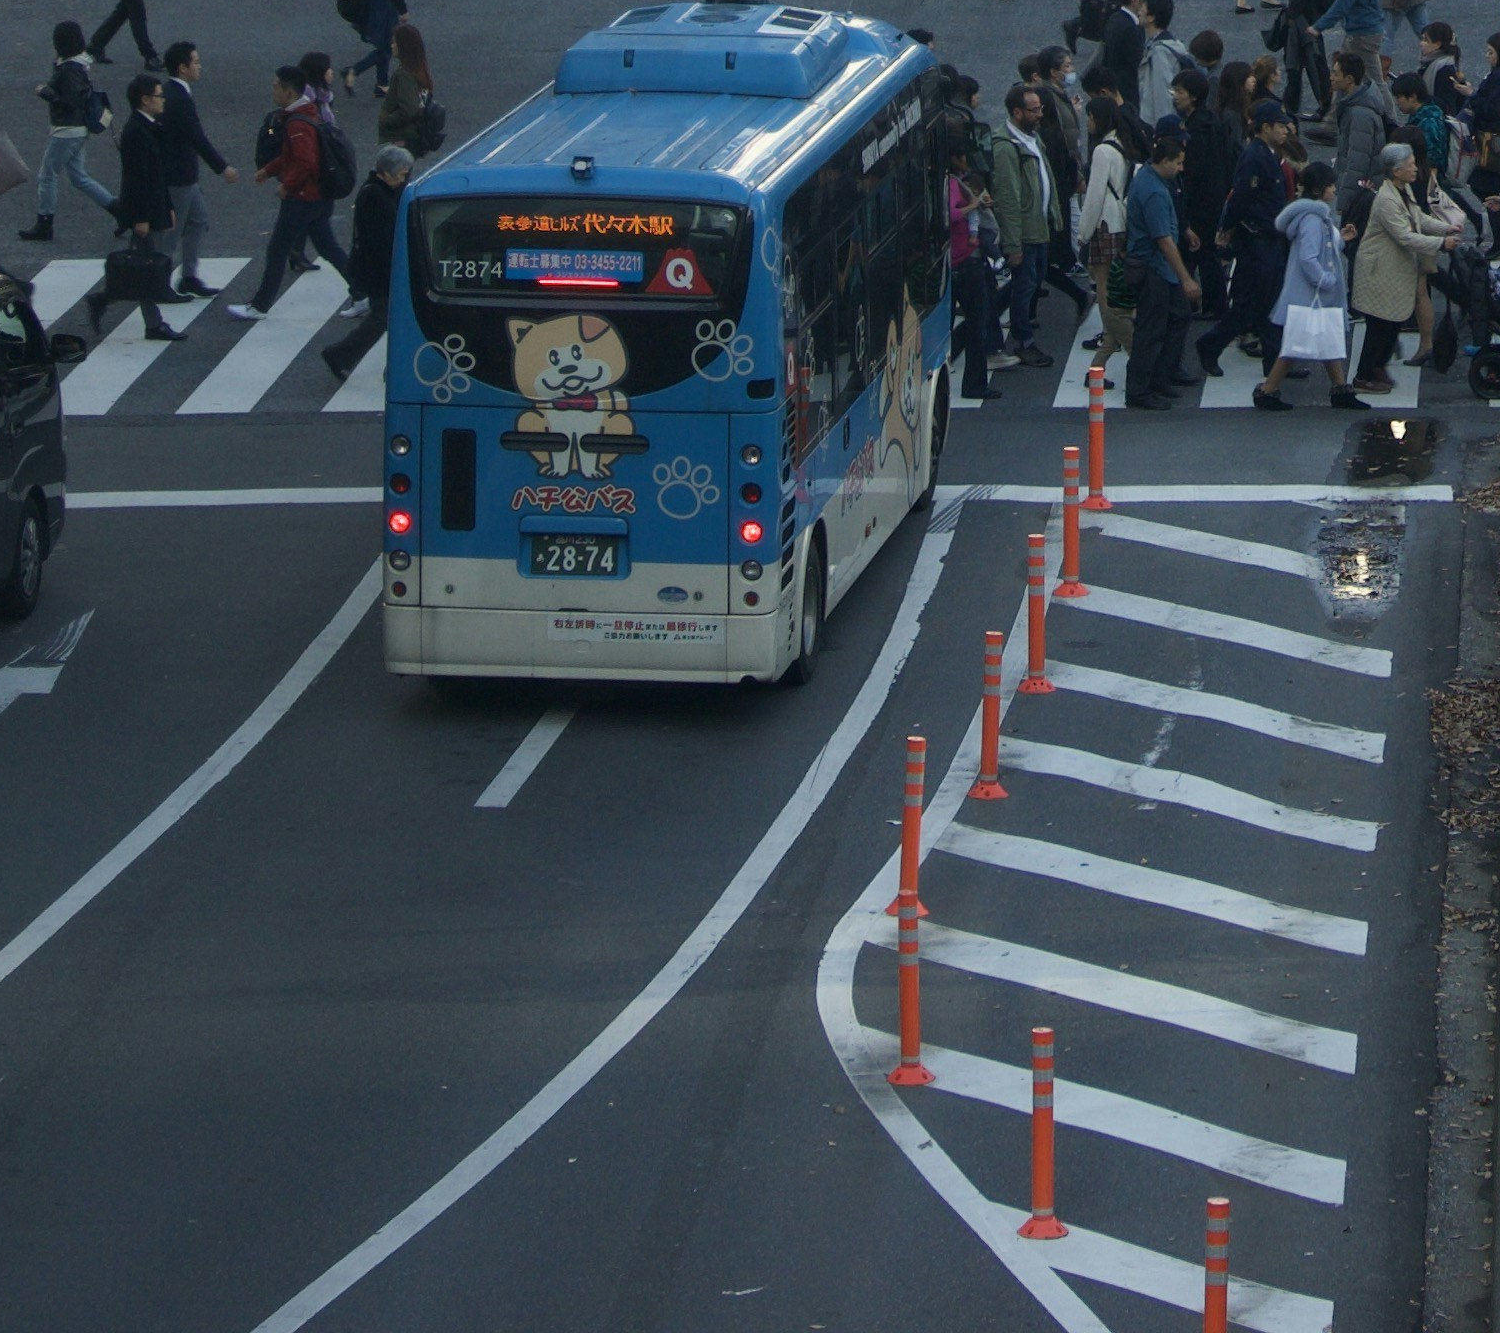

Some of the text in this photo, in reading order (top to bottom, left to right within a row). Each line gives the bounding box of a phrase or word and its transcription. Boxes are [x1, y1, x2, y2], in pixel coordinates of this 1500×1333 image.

[497, 213, 674, 237] 表参道ヒルズ 代々木駅
[438, 258, 504, 280] T2874
[574, 253, 643, 272] 03-3455-2211
[665, 256, 694, 292] Q
[509, 485, 637, 515] ハチ公バス
[546, 545, 614, 572] 28-74
